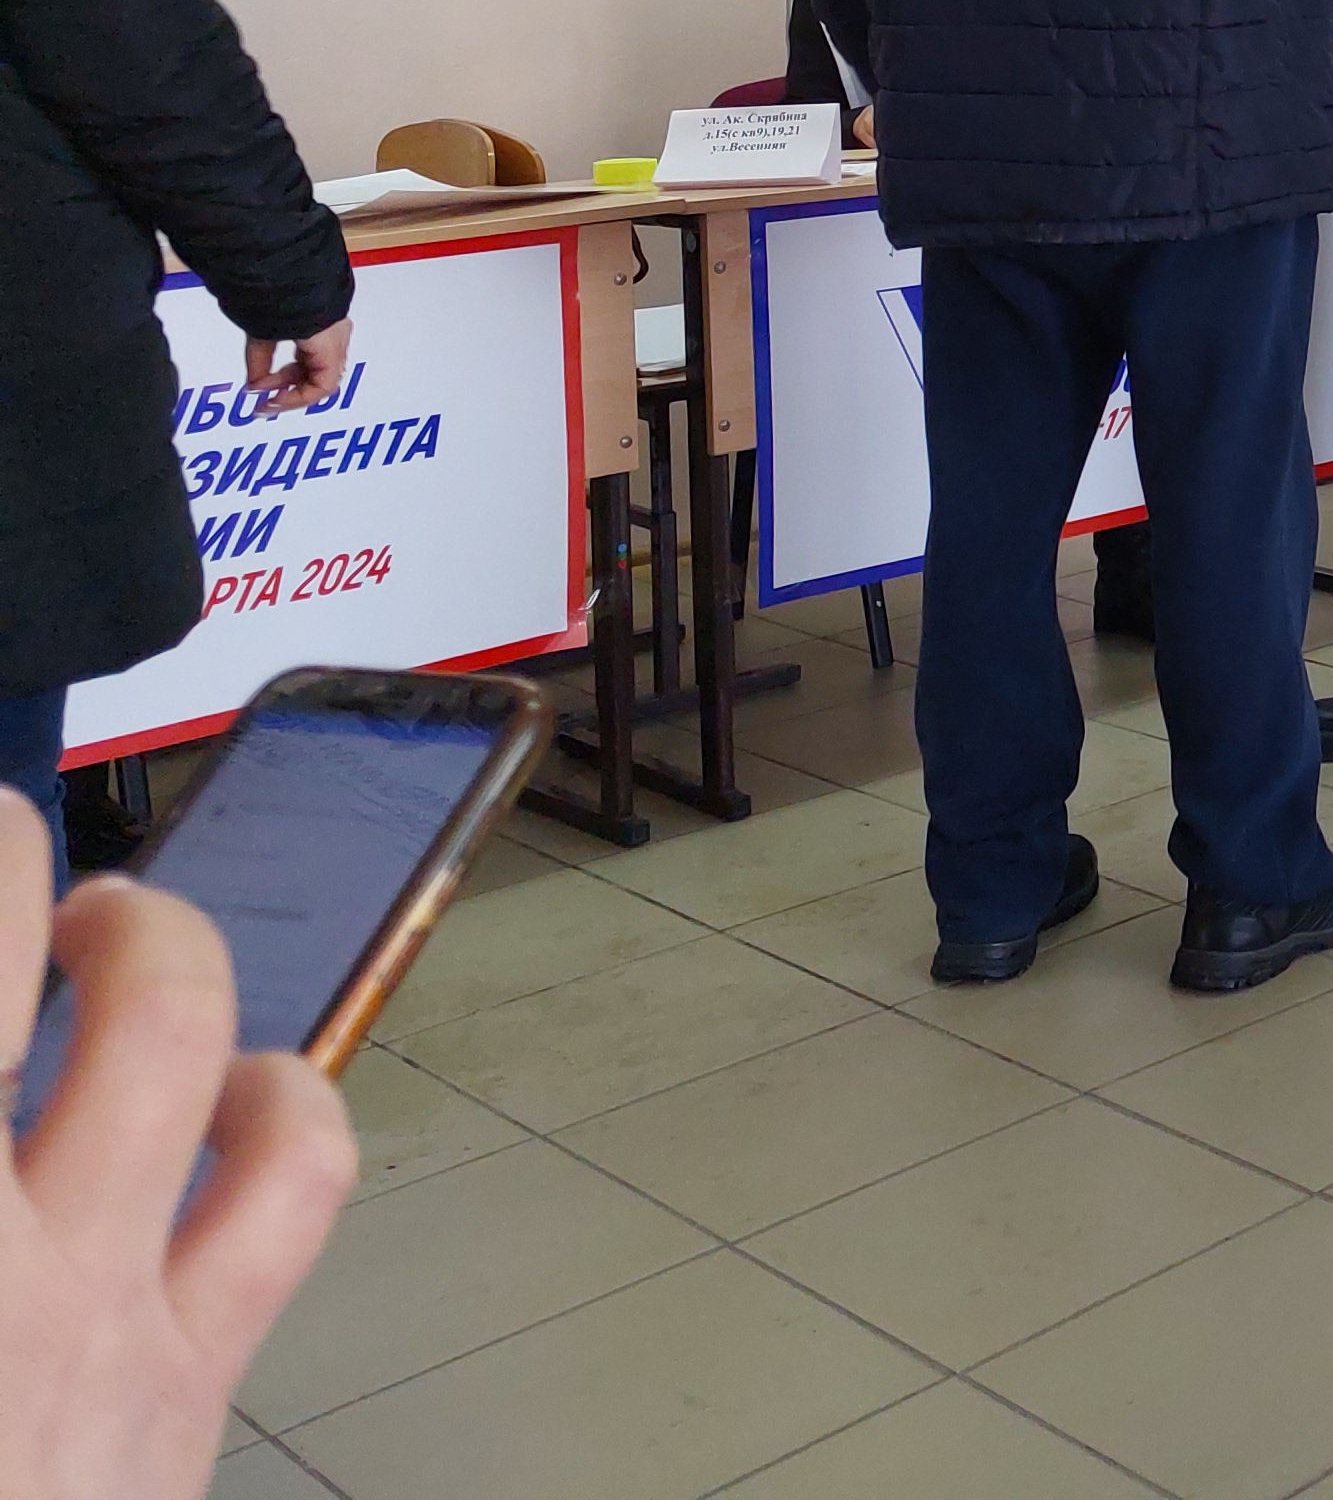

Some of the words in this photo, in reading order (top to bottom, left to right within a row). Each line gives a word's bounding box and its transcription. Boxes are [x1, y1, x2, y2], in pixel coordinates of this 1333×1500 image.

[701, 117, 720, 127] ул.
[722, 115, 744, 125] Ак.
[747, 111, 808, 126] Скрябина
[179, 413, 442, 501] ЗИДЕНТА
[202, 565, 284, 621] РТА
[289, 544, 393, 603] 2024
